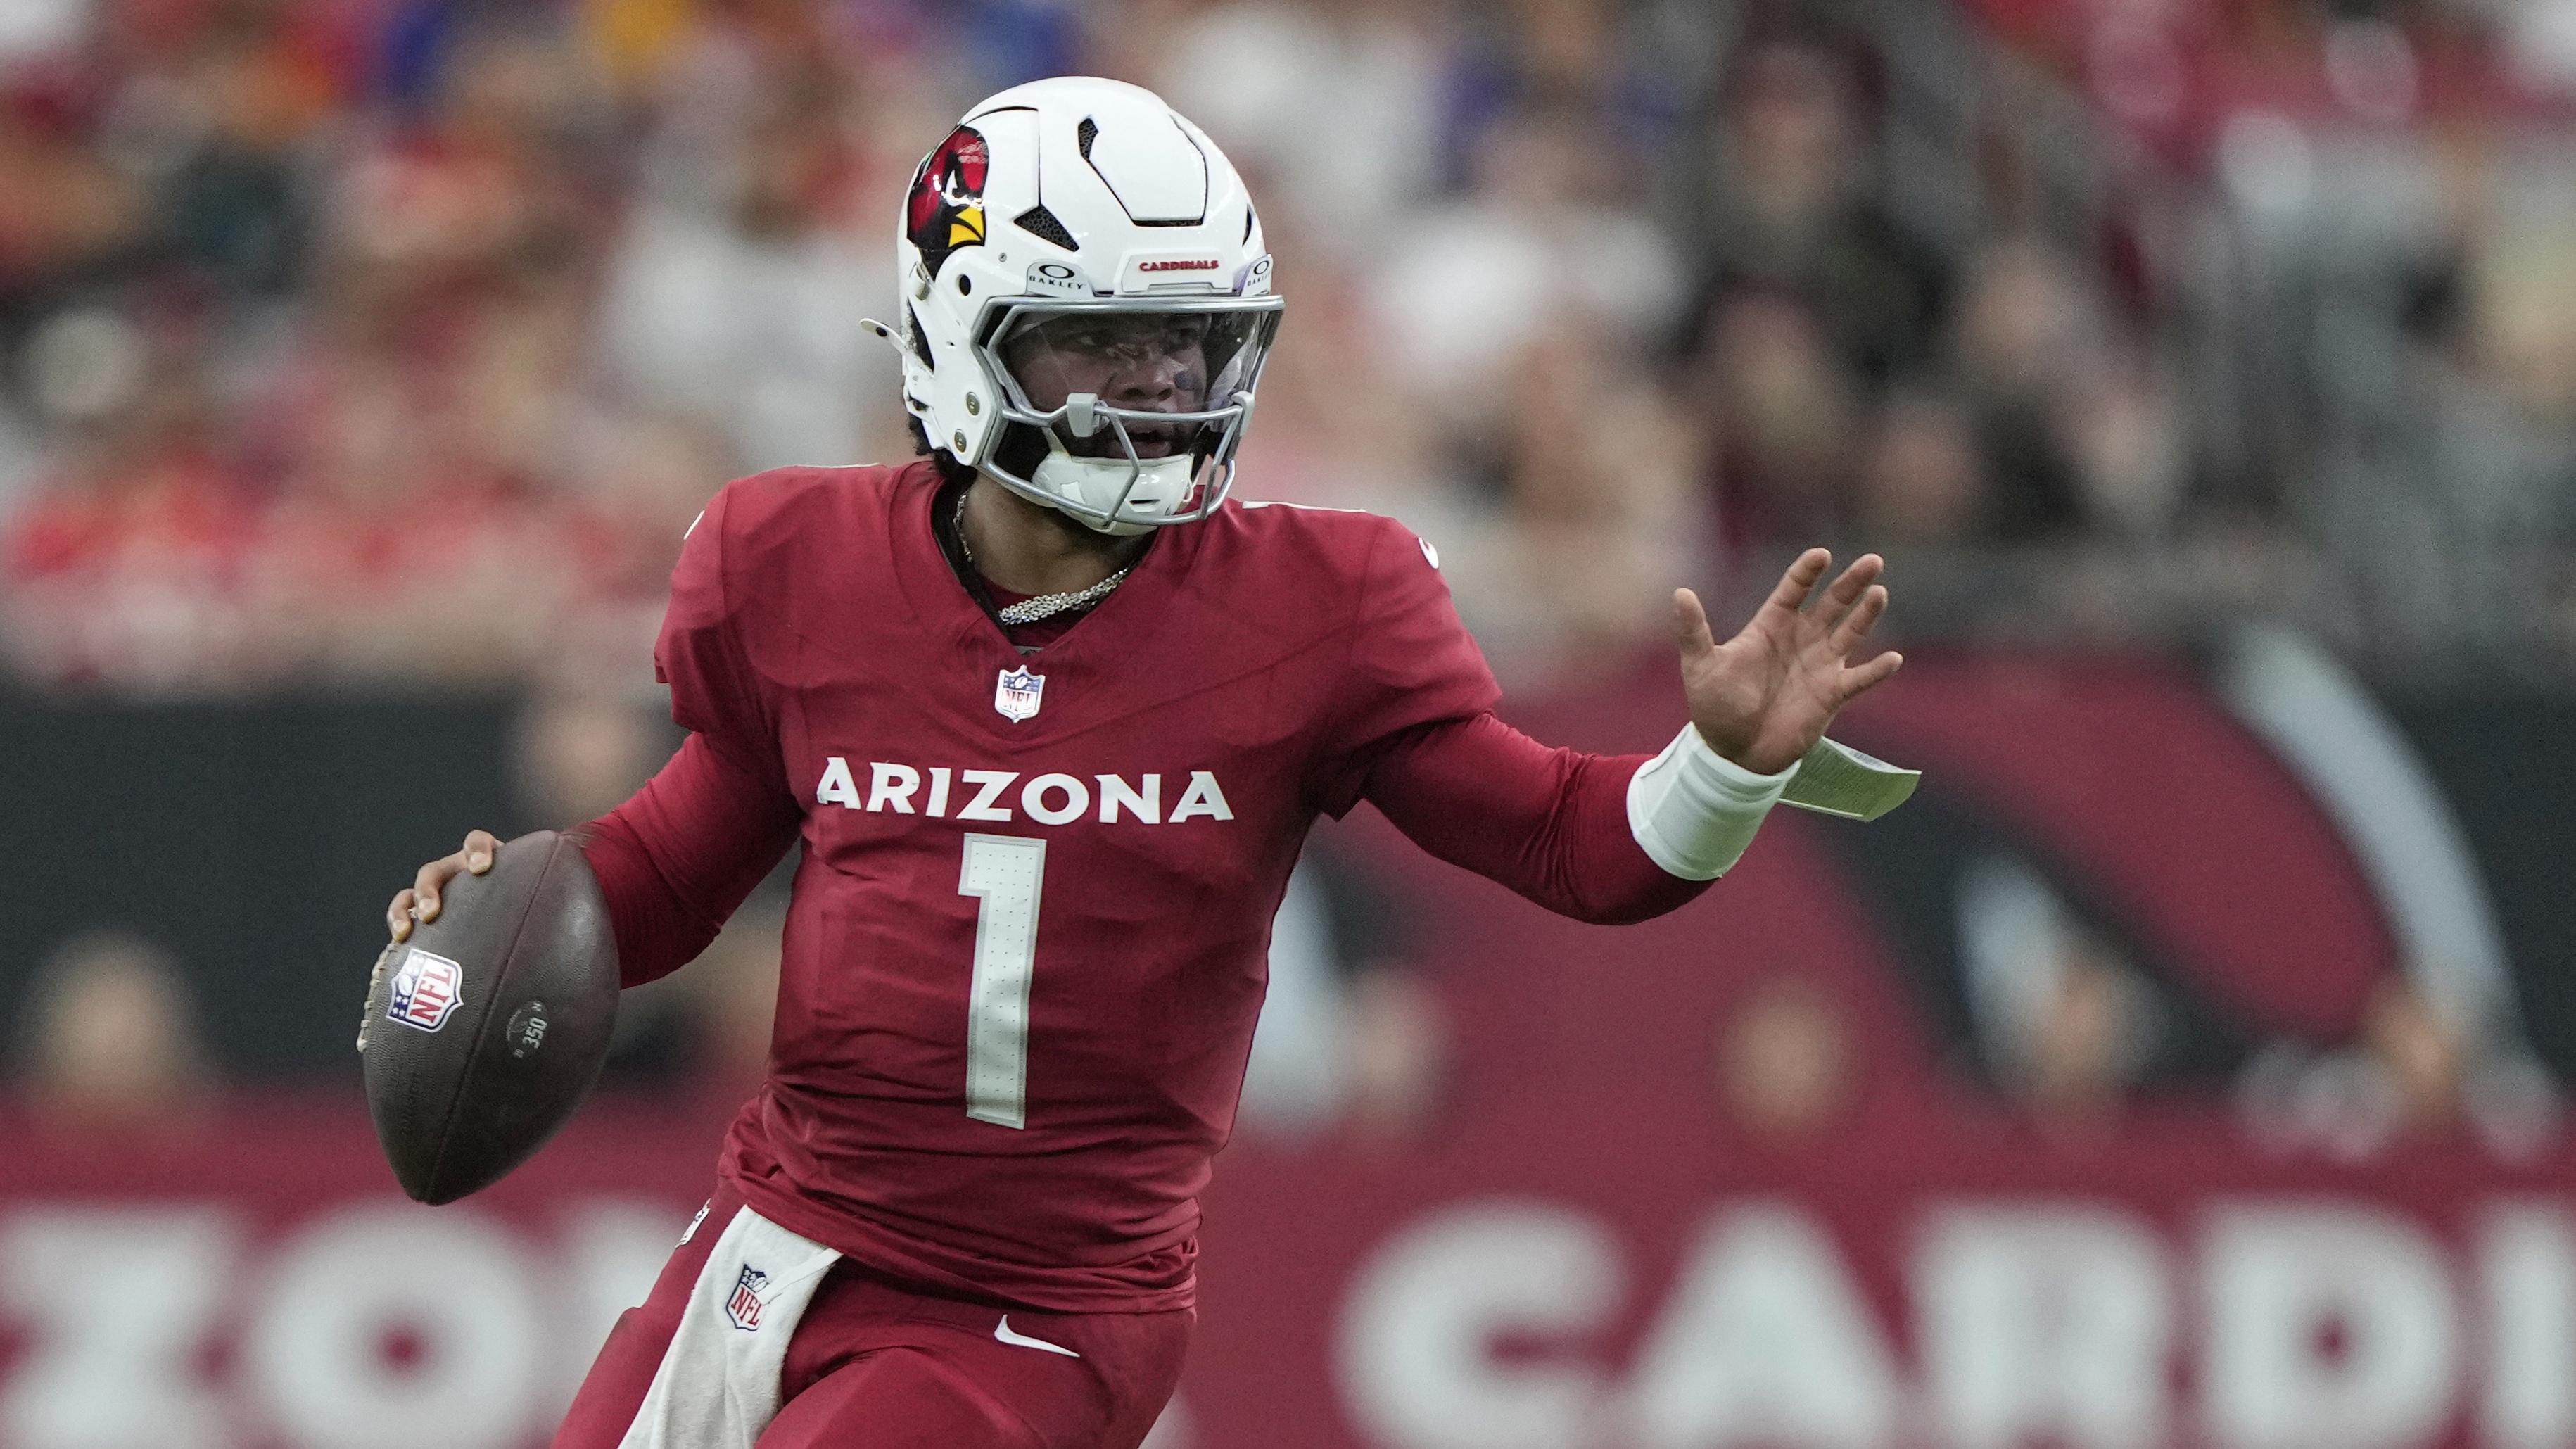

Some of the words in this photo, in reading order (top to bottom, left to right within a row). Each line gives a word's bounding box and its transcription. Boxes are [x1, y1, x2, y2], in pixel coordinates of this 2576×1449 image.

[1029, 275, 1084, 289] OAKLEY
[1139, 260, 1219, 272] CARDINALS
[817, 757, 1235, 825] ARIZONA
[410, 968, 452, 1024] NFL
[958, 832, 1048, 1130] 1
[522, 1016, 547, 1049] 350
[730, 1286, 763, 1326] NFL
[1333, 1198, 2576, 1449] CARDI
